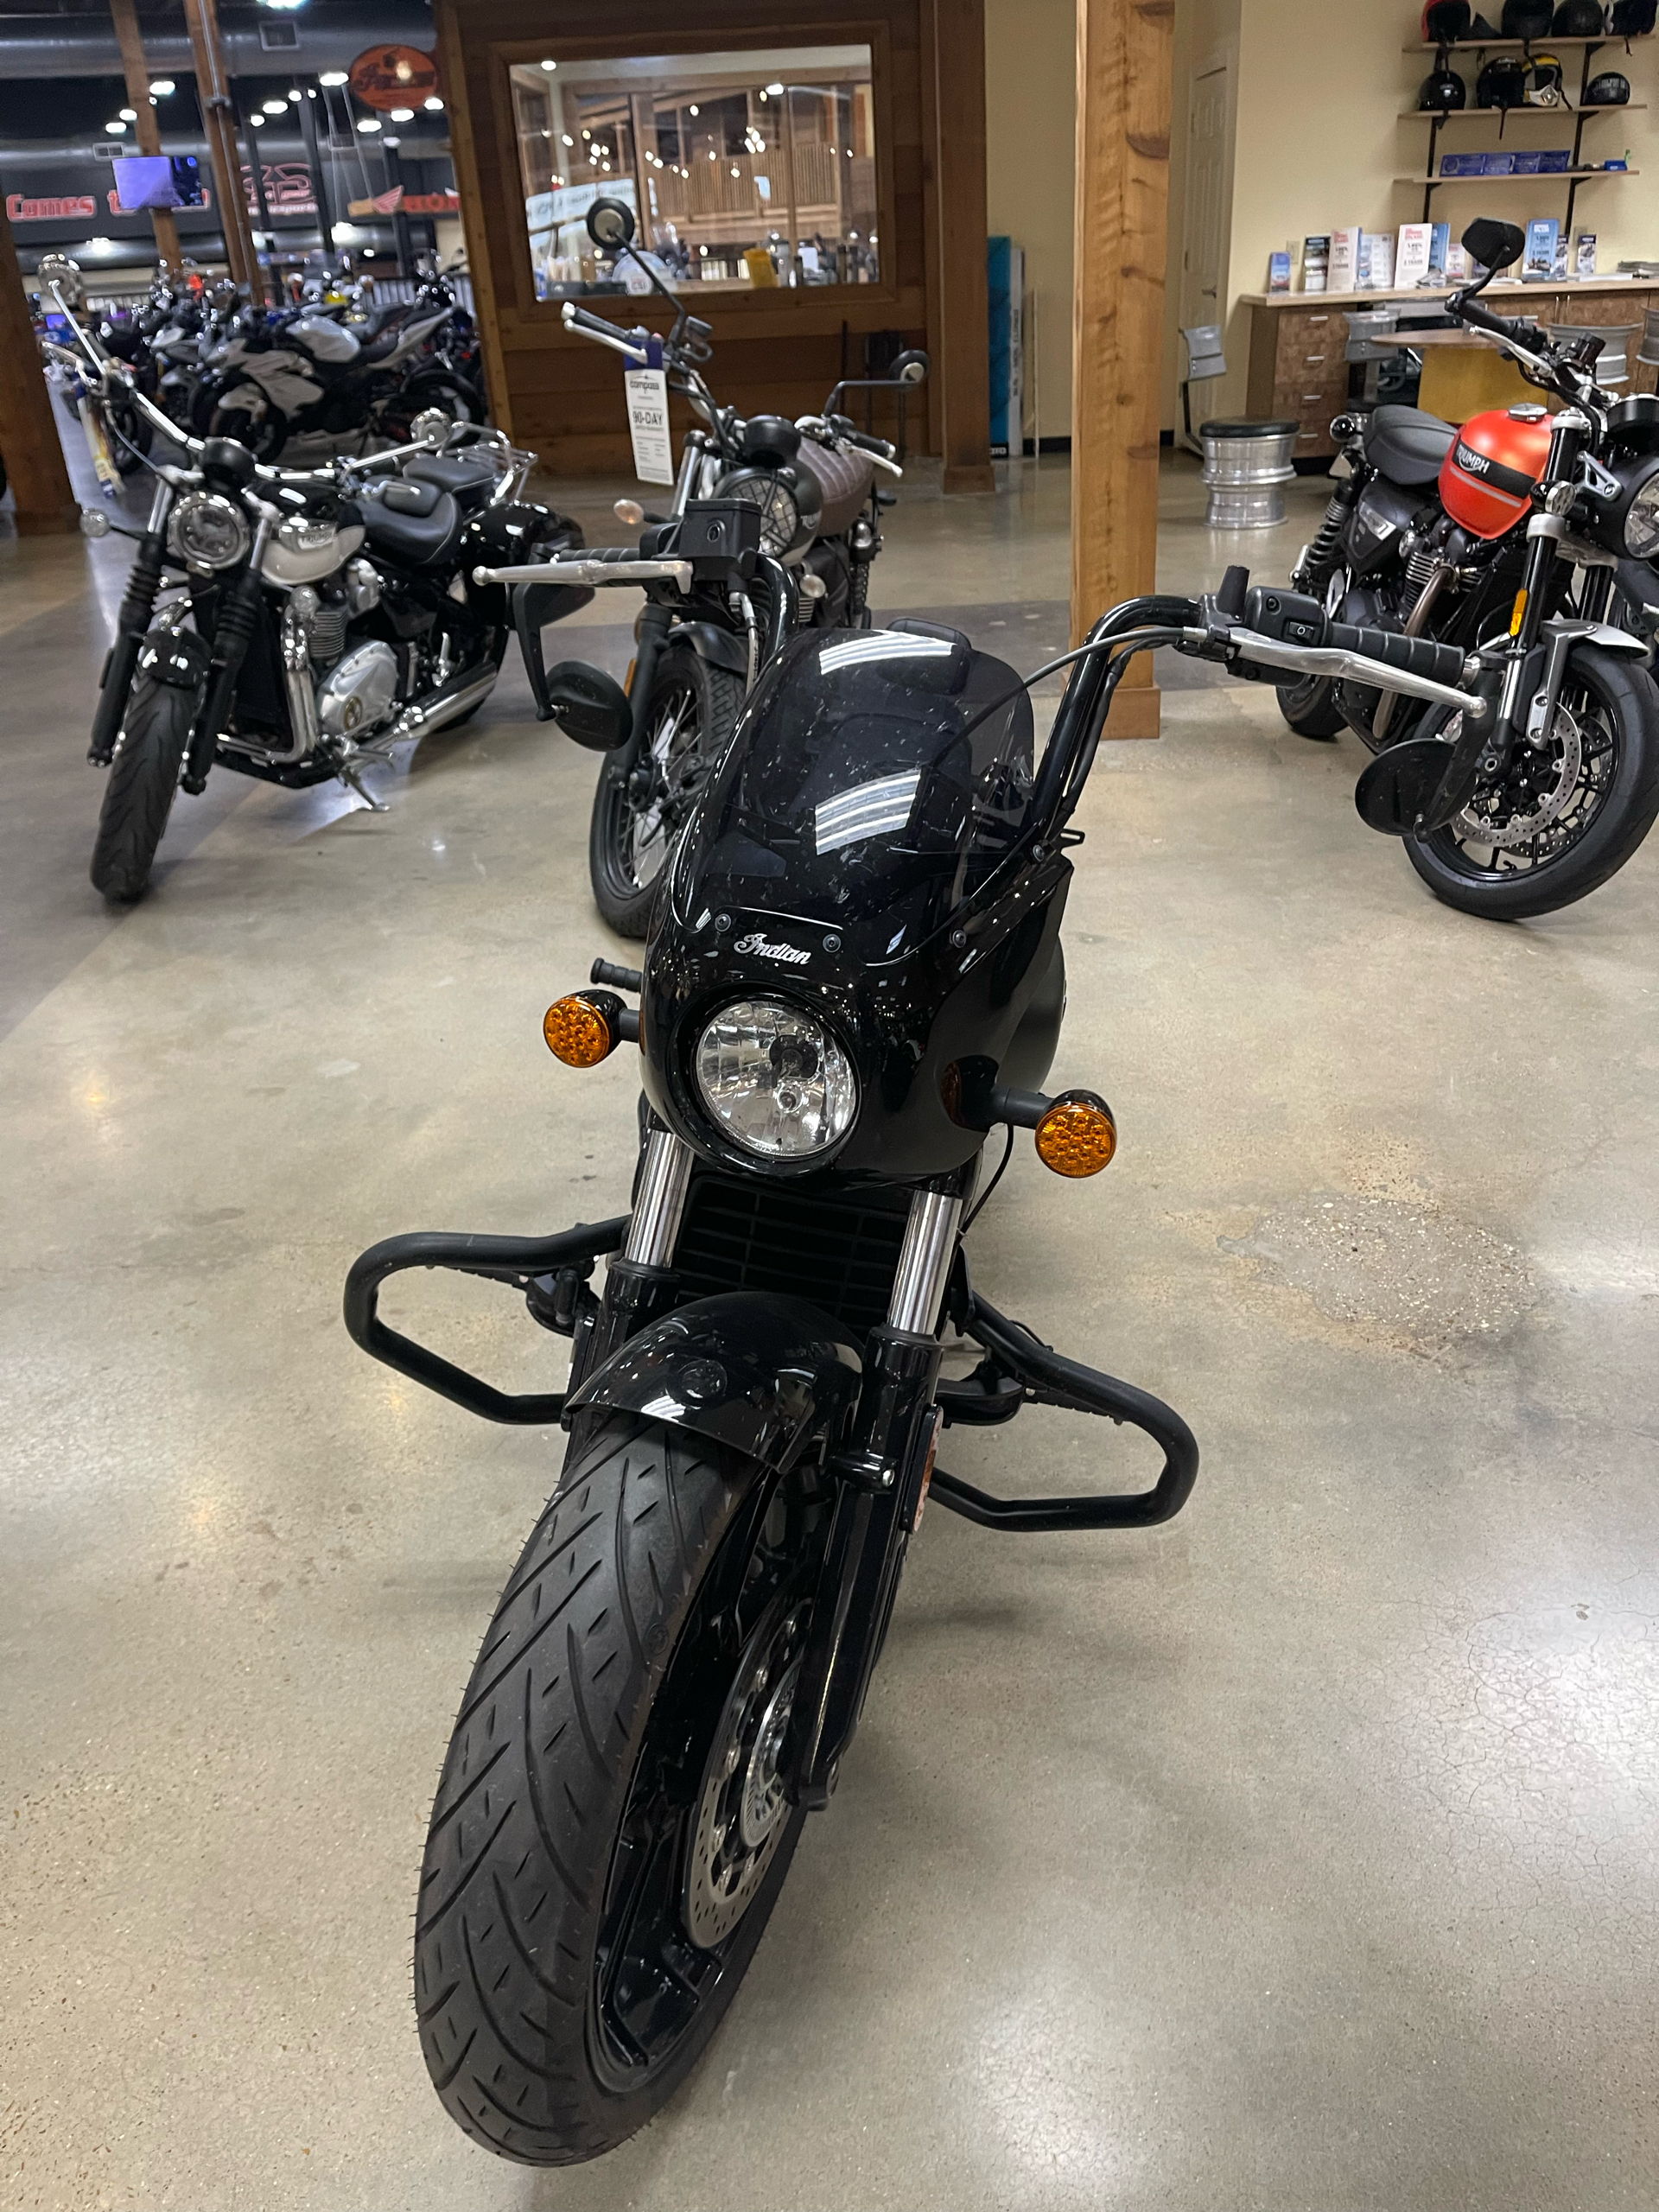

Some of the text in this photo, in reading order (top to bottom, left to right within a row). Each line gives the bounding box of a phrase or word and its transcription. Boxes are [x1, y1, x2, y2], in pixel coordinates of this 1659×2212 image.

[6, 194, 96, 221] Comes
[629, 380, 660, 394] compass
[632, 410, 663, 426] 90-DAY
[1454, 443, 1491, 474] TRIUMPH
[733, 932, 812, 965] Indian
